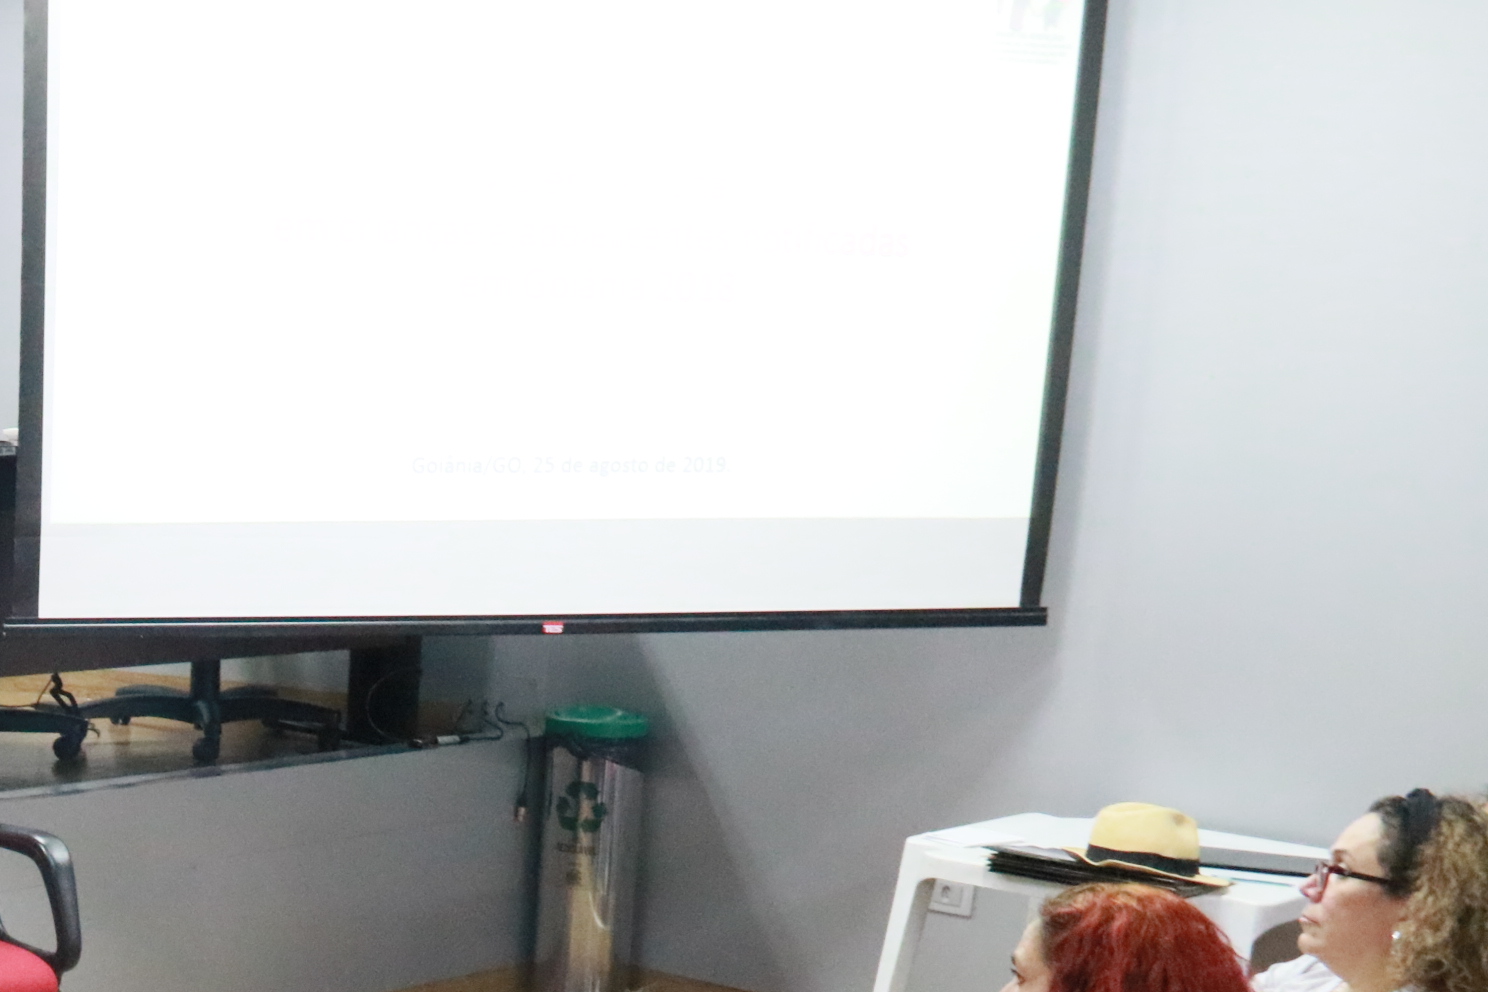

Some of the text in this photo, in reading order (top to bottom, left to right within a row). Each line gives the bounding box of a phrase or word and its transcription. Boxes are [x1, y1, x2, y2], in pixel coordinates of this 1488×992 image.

[531, 456, 556, 474] 25
[560, 455, 584, 474] de
[588, 456, 650, 478] agosto
[654, 455, 678, 474] de
